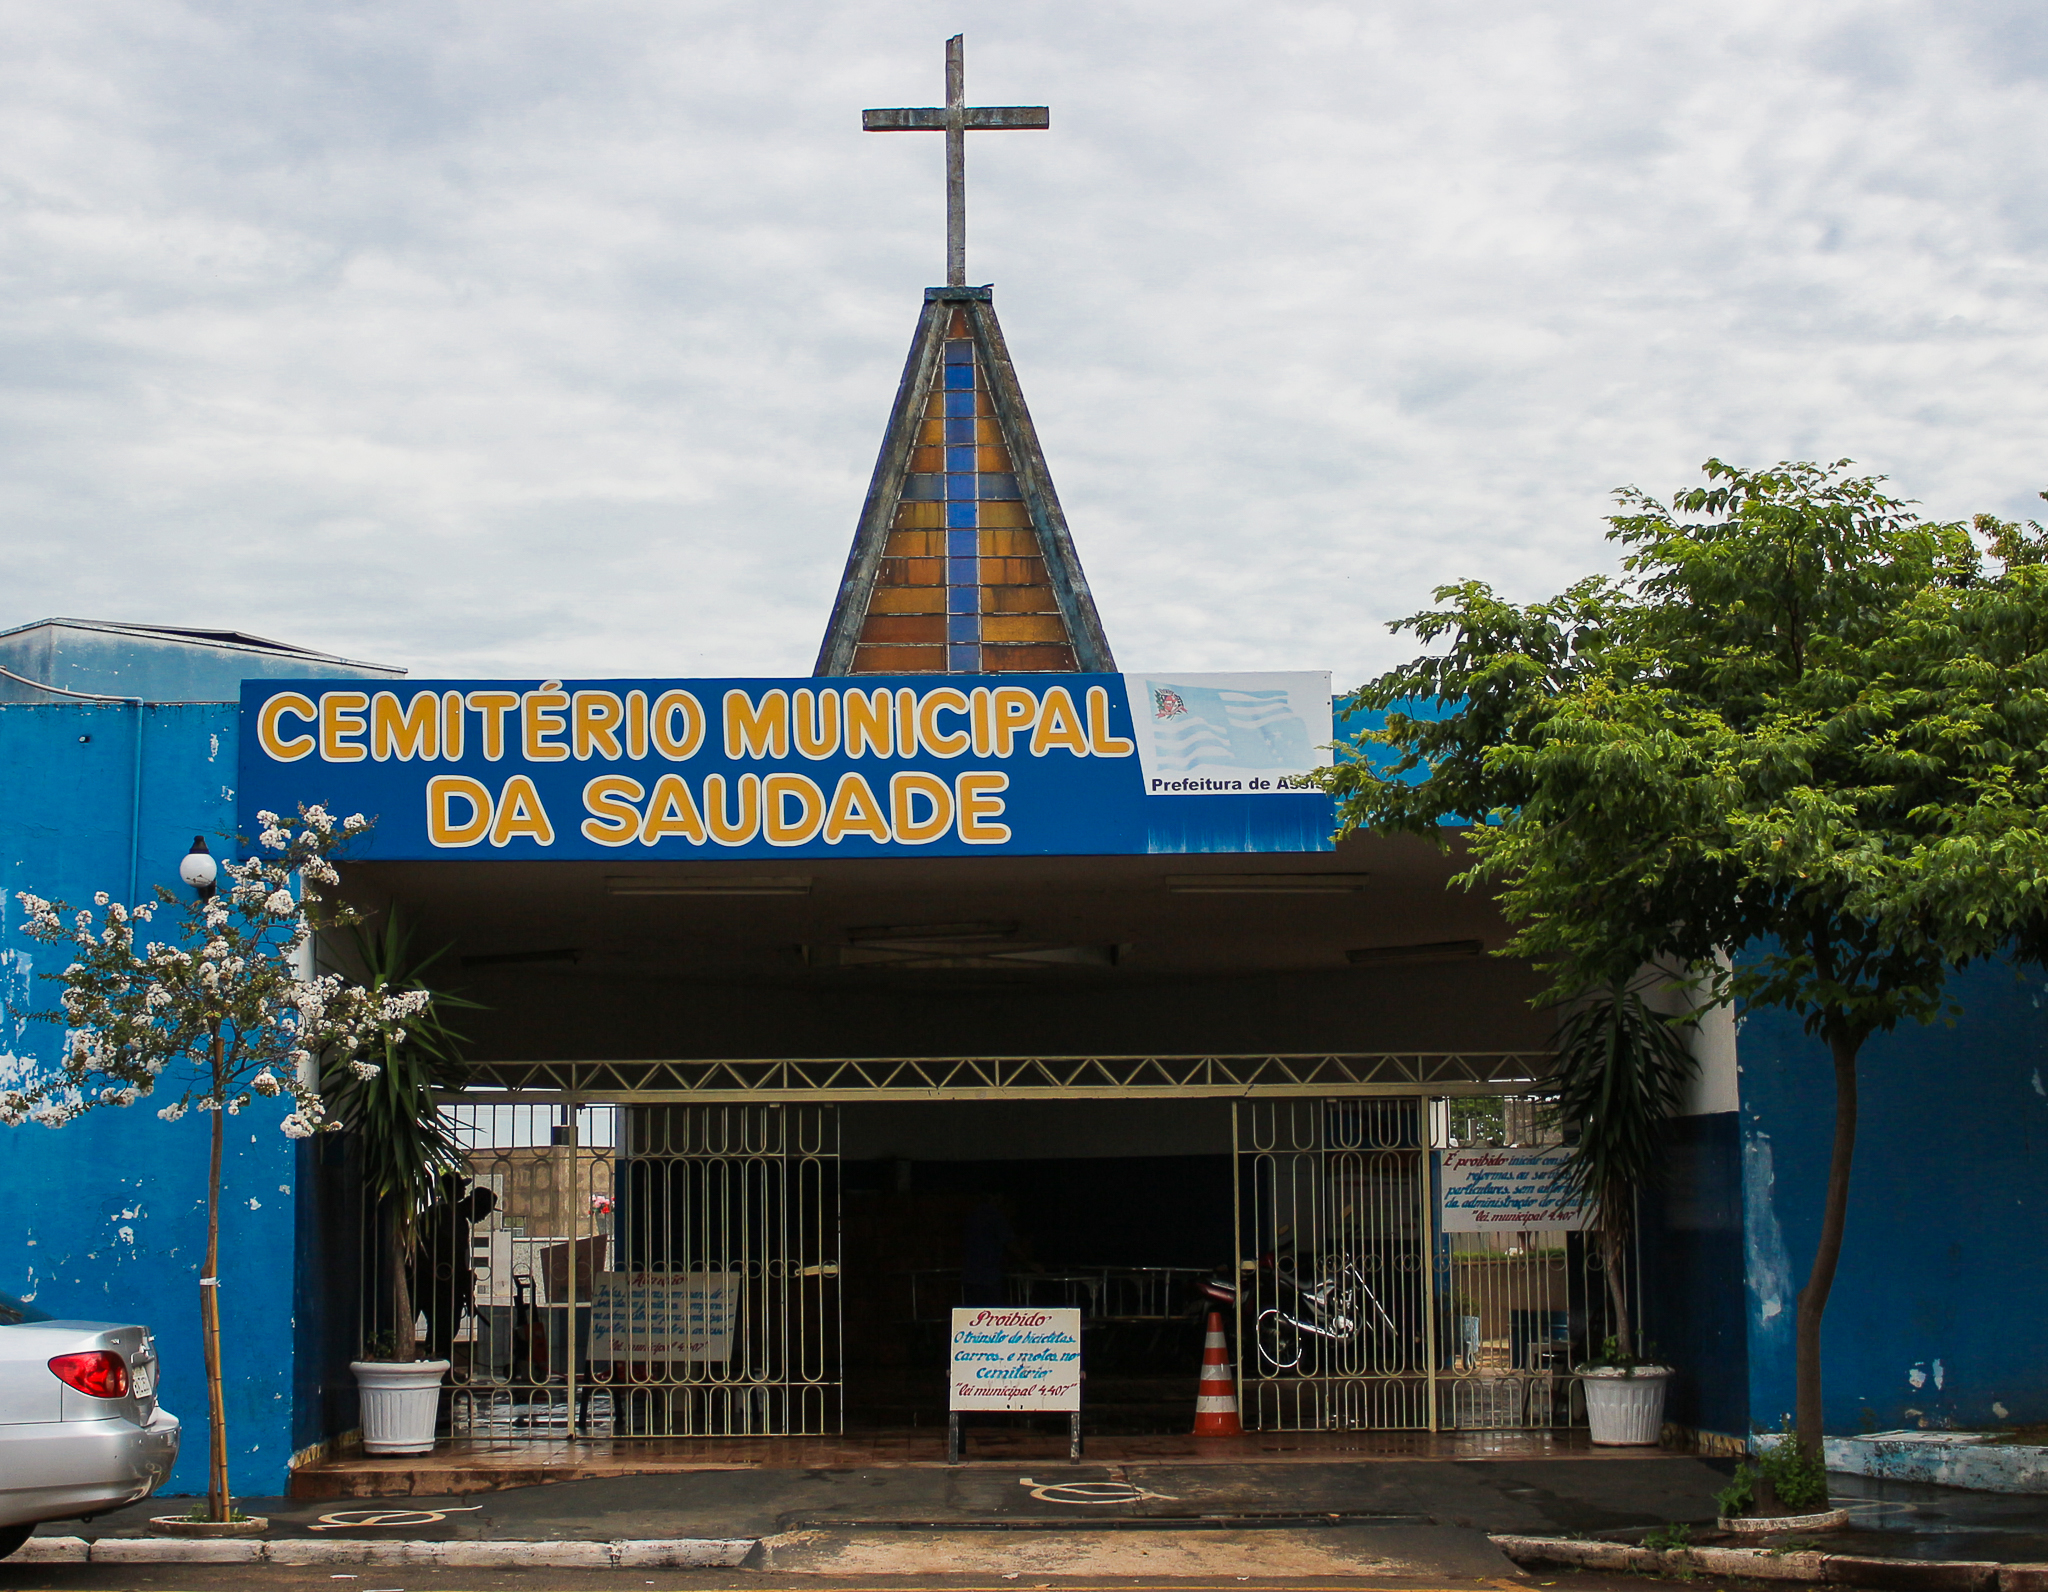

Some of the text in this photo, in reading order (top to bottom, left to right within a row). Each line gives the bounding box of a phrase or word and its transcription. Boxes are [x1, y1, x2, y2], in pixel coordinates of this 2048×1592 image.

[257, 679, 1134, 763] CEMITÉRIO MUNICIPAL
[1151, 777, 1242, 791] Prefeitura
[1248, 776, 1271, 790] de
[426, 770, 1013, 848] DA SAUDADE
[1453, 1152, 1509, 1171] proibido
[1512, 1184, 1535, 1194] sem
[1490, 1209, 1549, 1226] municipal
[969, 1310, 1052, 1326] Proibido
[1007, 1352, 1016, 1362] e
[1059, 1352, 1080, 1362] no
[974, 1383, 1038, 1401] municipal
